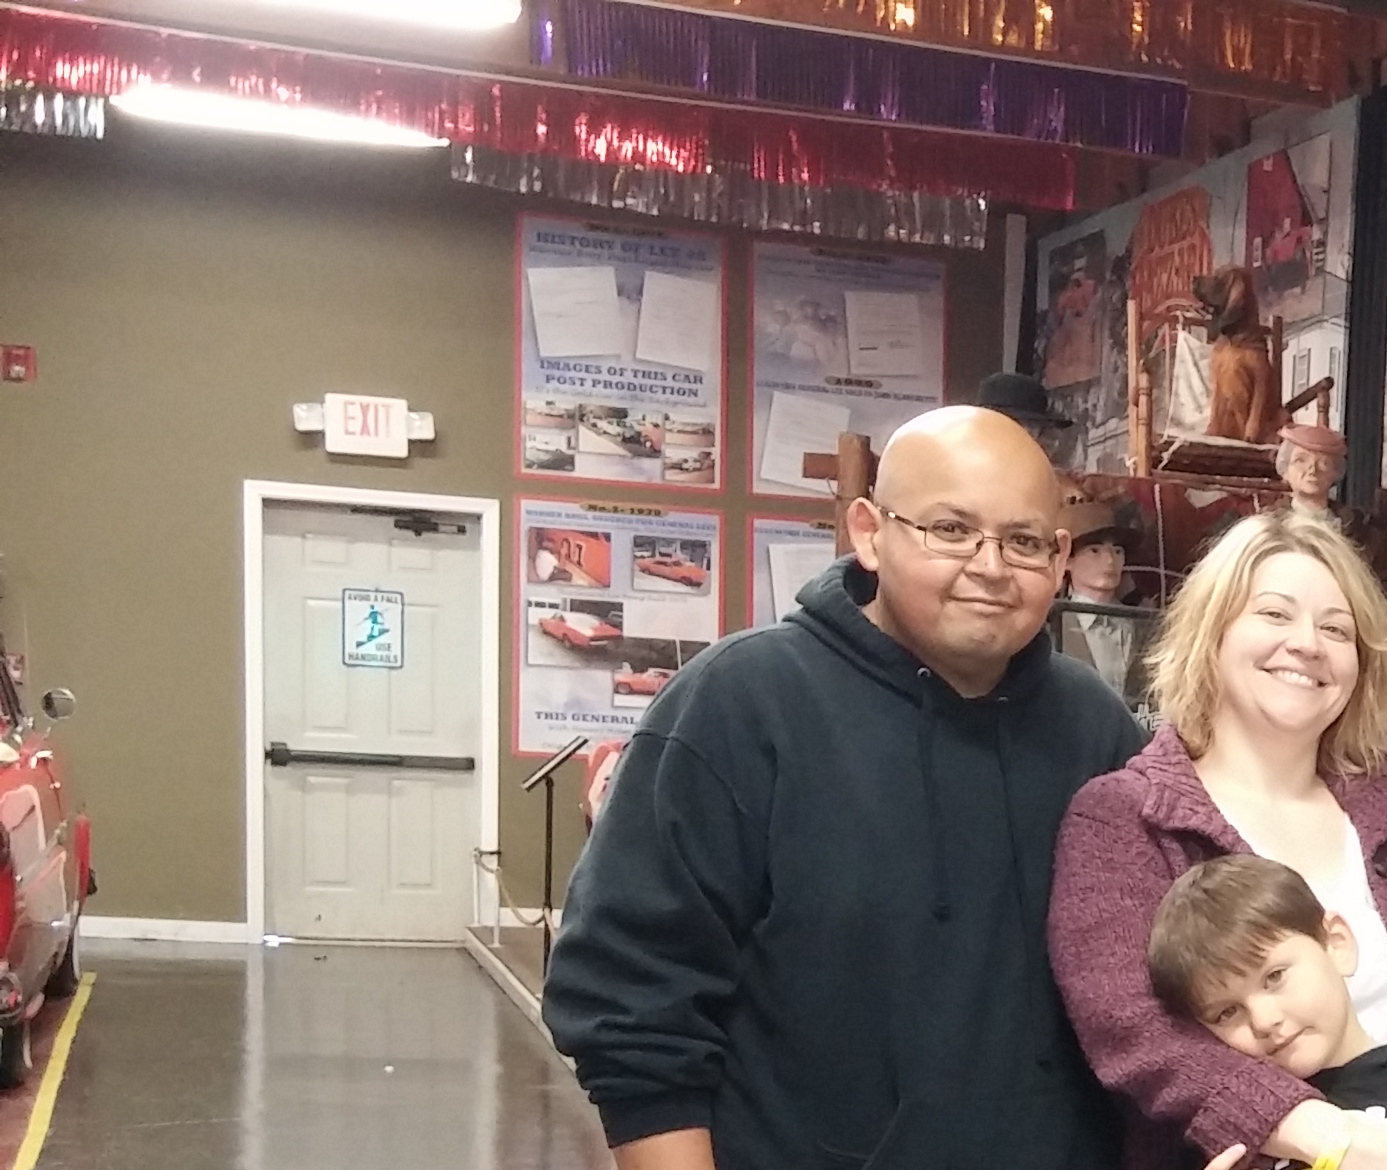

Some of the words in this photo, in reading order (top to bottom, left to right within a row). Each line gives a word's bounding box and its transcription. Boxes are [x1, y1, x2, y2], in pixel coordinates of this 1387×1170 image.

[539, 359, 603, 376] IMAGES
[606, 366, 626, 378] OF
[630, 368, 667, 381] THIS
[672, 372, 704, 385] CAR
[545, 374, 587, 387] POST
[591, 379, 699, 398] PRODUCTION
[343, 401, 392, 437] EXIT
[348, 594, 371, 603] AVOID
[380, 595, 399, 604] FALL
[375, 642, 392, 651] USE
[347, 653, 398, 664] HANDRAILS
[535, 711, 567, 721] THIS
[571, 711, 637, 724] GENERAL
